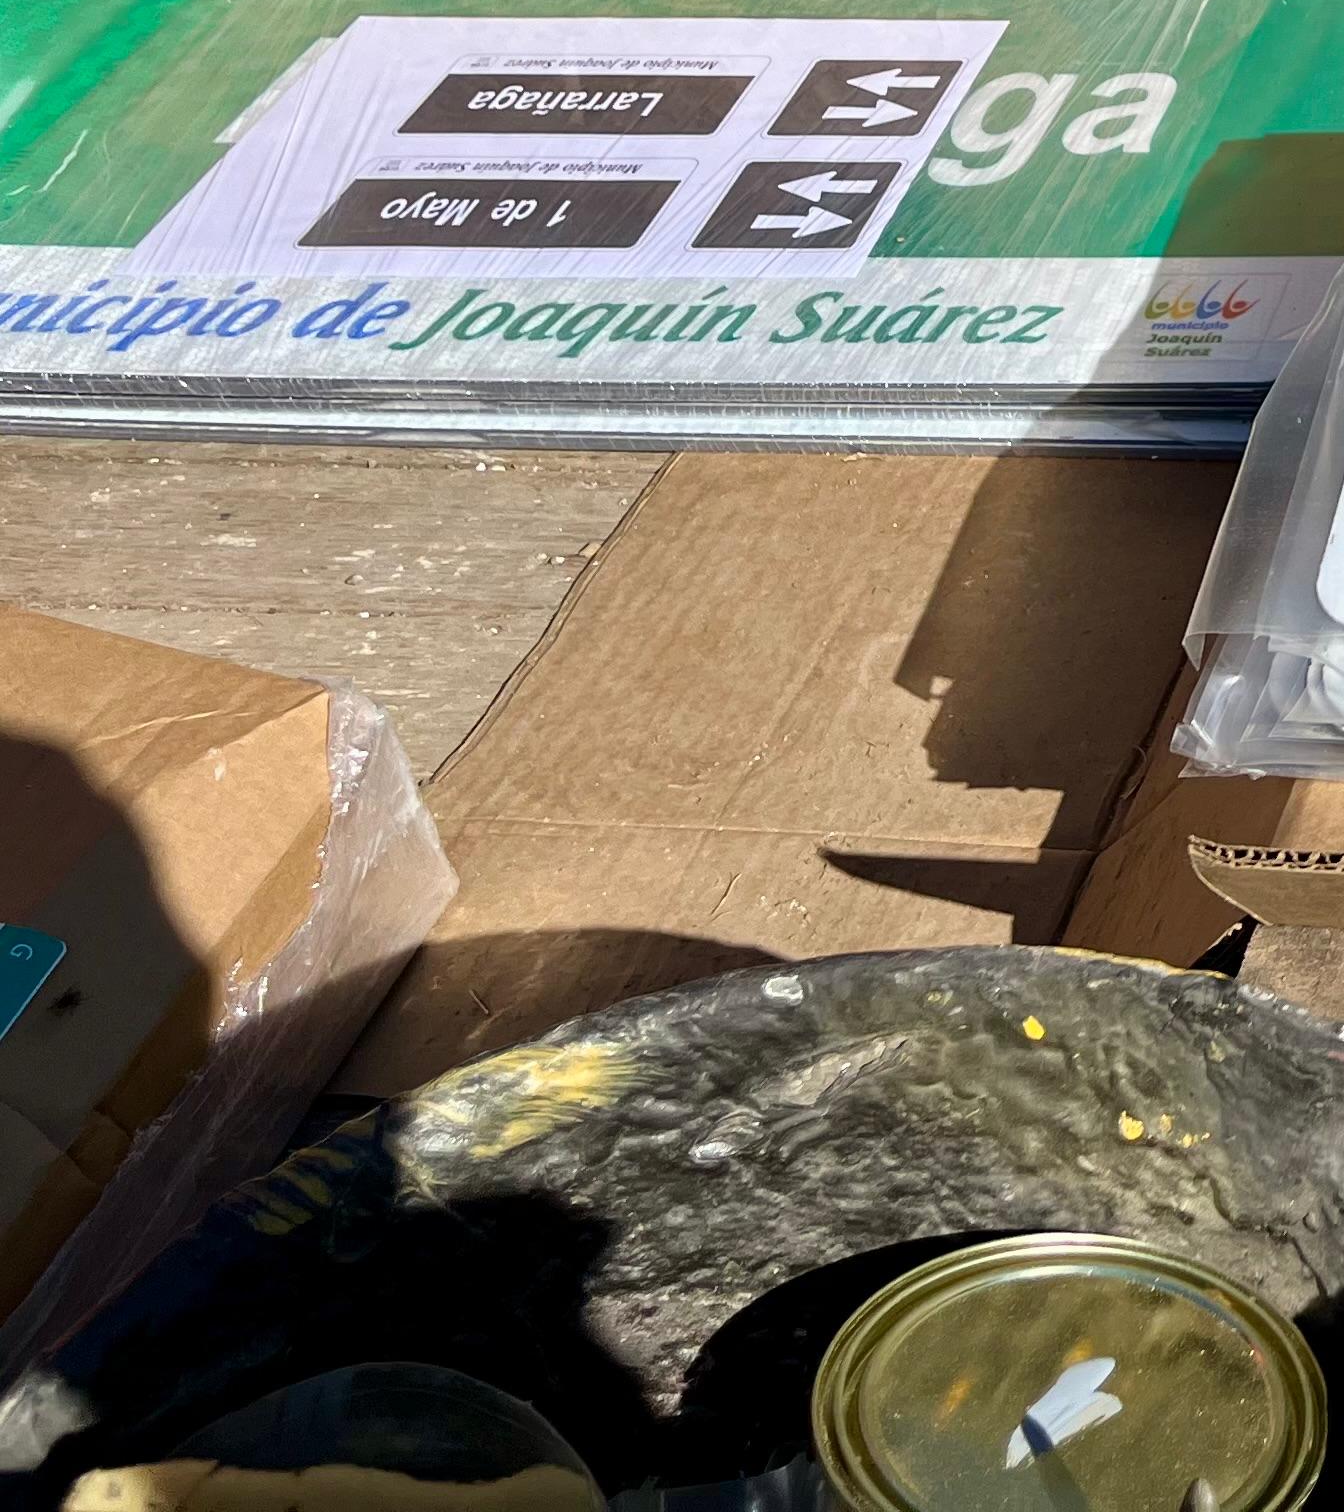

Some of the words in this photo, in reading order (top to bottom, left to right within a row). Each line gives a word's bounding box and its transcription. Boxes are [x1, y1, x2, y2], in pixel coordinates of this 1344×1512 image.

[468, 85, 664, 117] Larrañaga
[928, 69, 1178, 188] ga
[380, 191, 480, 228] Mayo
[491, 198, 539, 227] de
[546, 198, 572, 228] 1
[0, 278, 282, 353] nicipio
[292, 281, 411, 340] de
[390, 285, 757, 358] Joaquín
[771, 286, 1066, 345] Suárez
[1146, 332, 1223, 346] Joaquín
